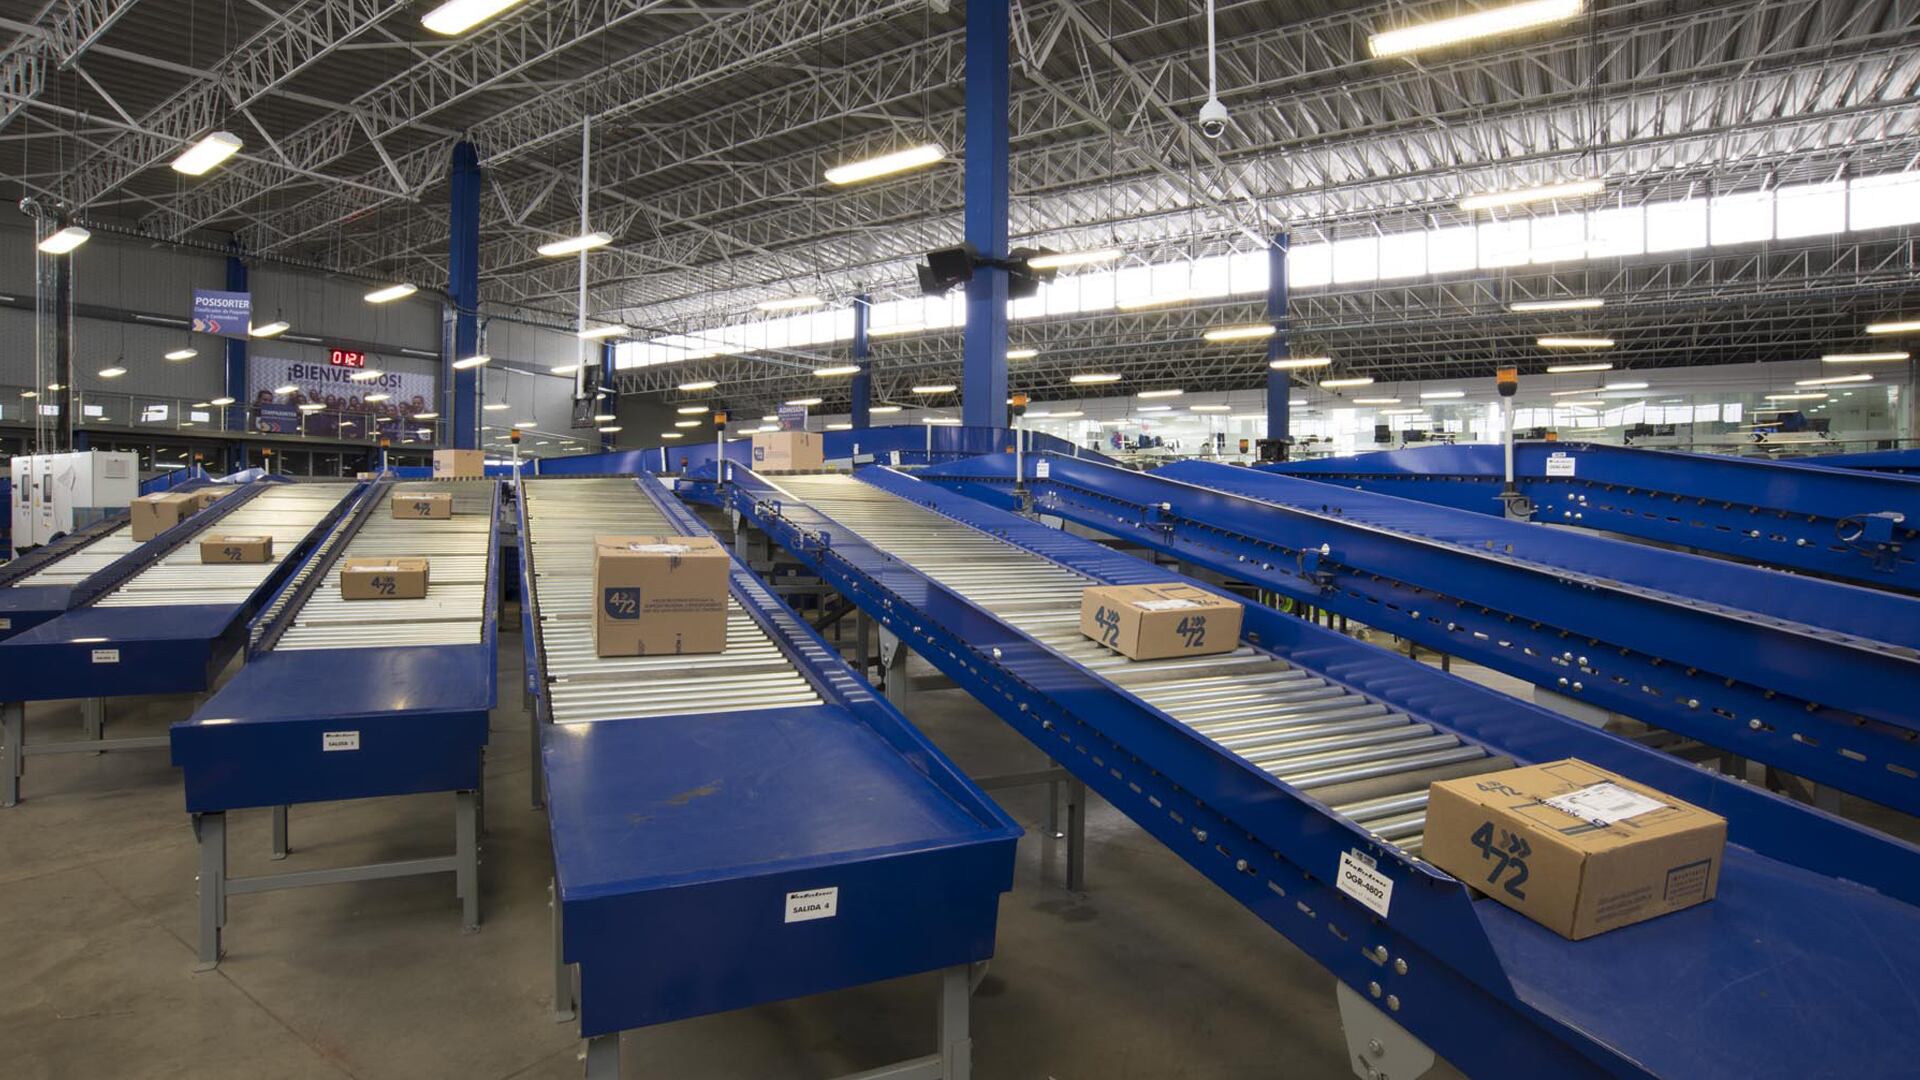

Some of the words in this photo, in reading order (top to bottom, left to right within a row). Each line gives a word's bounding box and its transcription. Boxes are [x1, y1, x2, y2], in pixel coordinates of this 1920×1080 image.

[195, 297, 250, 308] POSISORTER
[1345, 871, 1384, 899] OGR-4802
[793, 903, 821, 914] SALIDA
